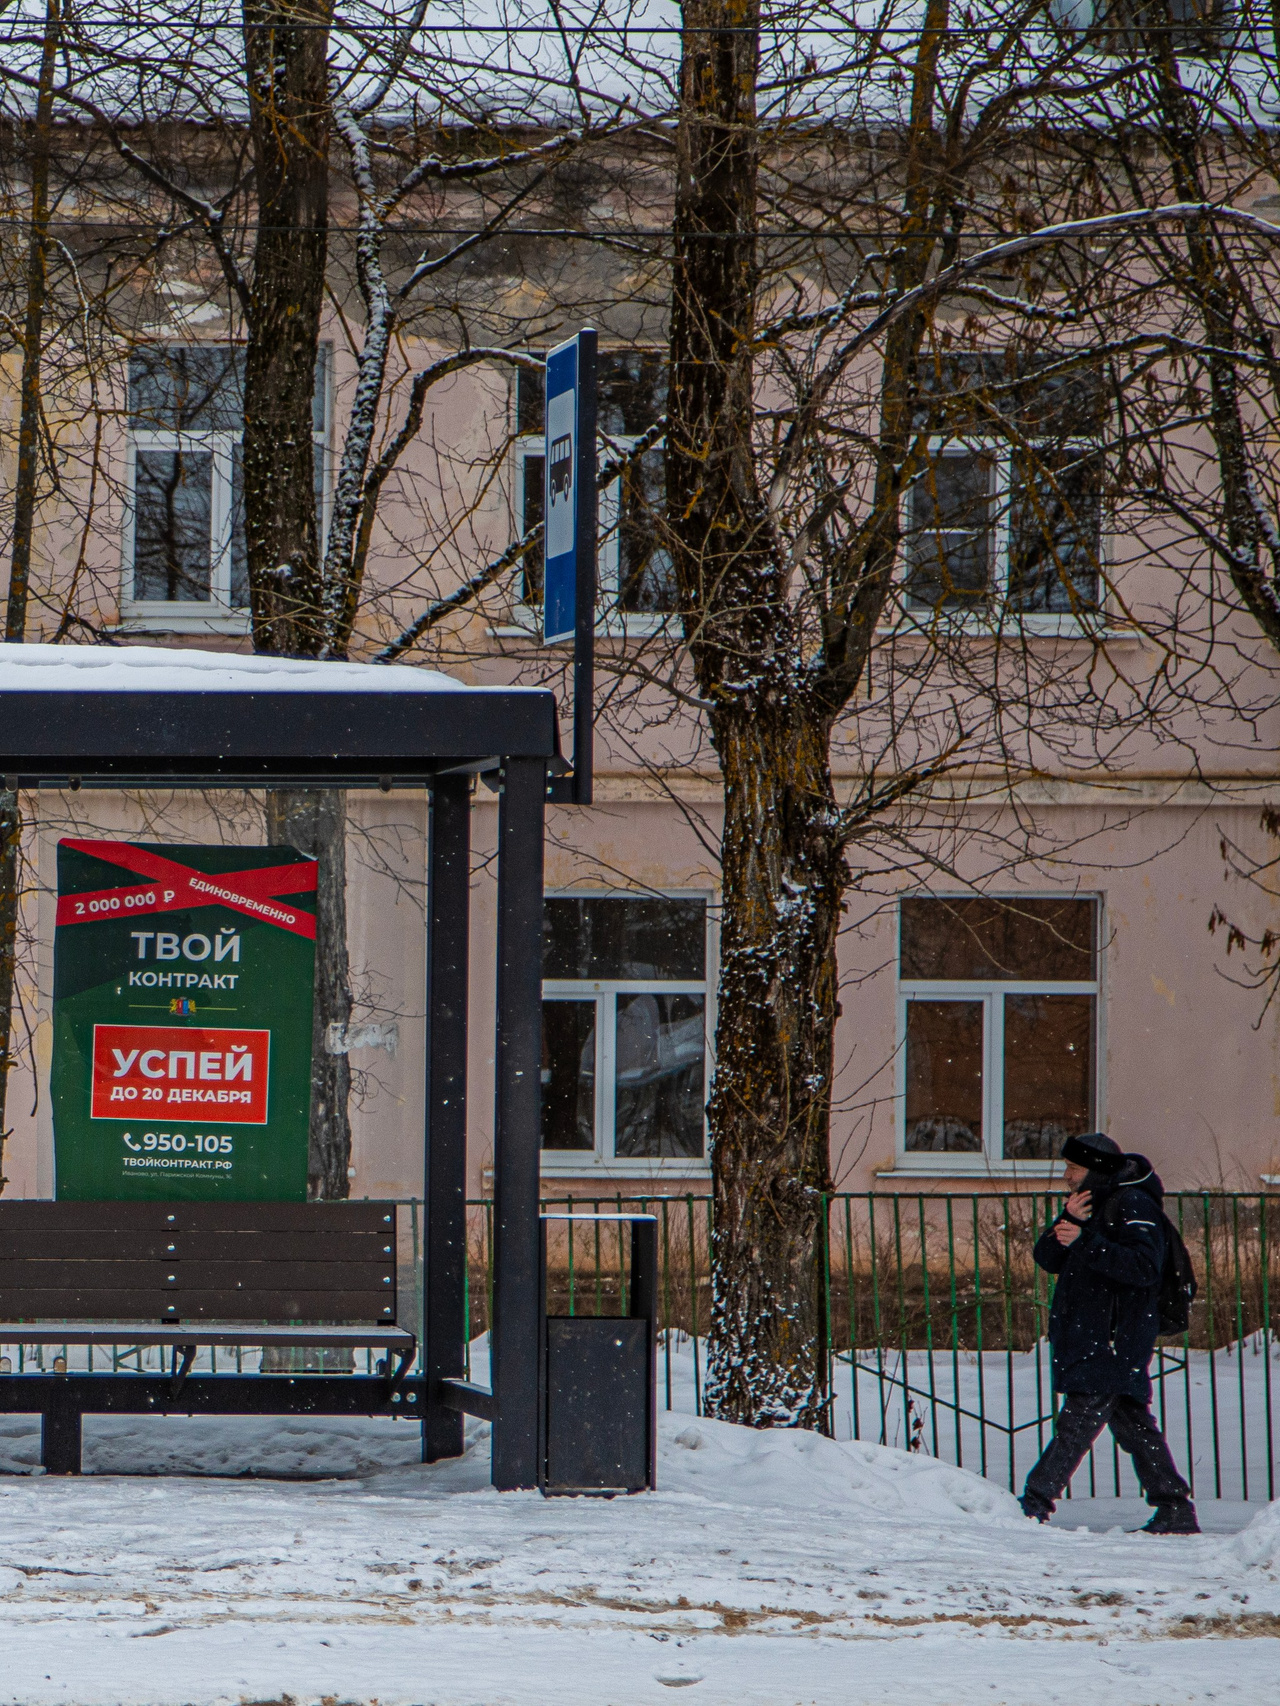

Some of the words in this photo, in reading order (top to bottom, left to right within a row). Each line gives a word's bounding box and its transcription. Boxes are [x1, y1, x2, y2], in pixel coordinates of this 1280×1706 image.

[75, 902, 85, 914] 2
[89, 897, 120, 913] 000
[124, 892, 156, 908] 000
[189, 877, 296, 925] ЕДИНОВРЕМЕННО
[131, 927, 240, 962] ТВОЙ
[129, 971, 239, 989] КОНТРАКТ
[111, 1045, 253, 1081] УСПЕЙ
[110, 1086, 138, 1101] ДО
[142, 1087, 163, 1100] 20
[167, 1088, 252, 1103] ДЕКАБРЯ
[143, 1133, 233, 1153] 950-105
[122, 1156, 233, 1170] ТВОЙКОНТРАКТ.РФ
